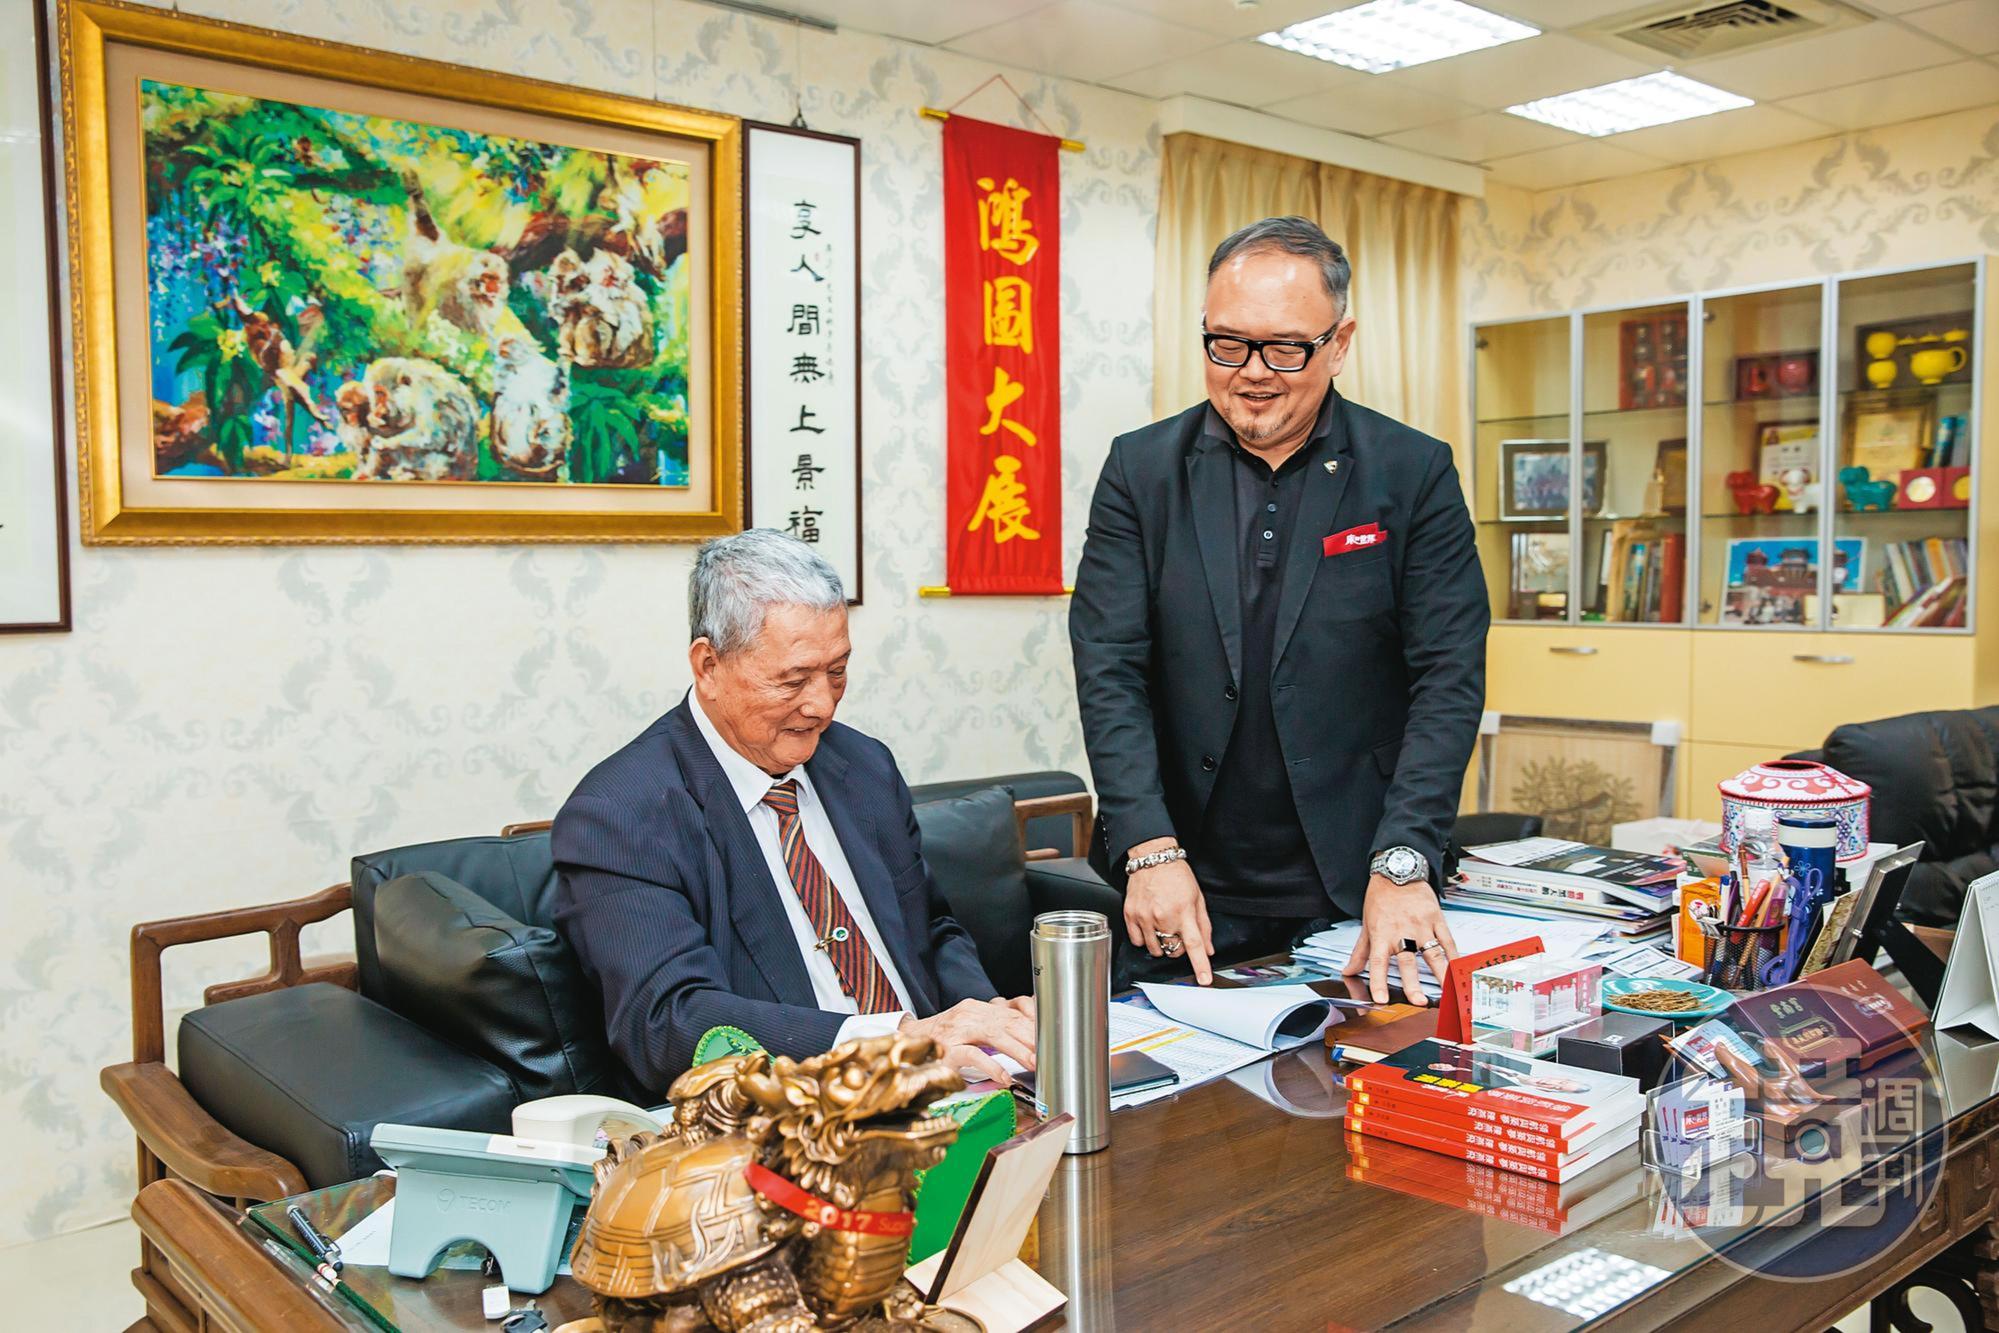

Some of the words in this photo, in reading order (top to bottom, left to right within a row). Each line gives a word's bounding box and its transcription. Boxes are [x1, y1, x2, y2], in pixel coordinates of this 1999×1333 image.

[967, 177, 1041, 544] 鴻圖大展
[460, 1195, 511, 1213] TECOM
[804, 1199, 873, 1230] 2017
